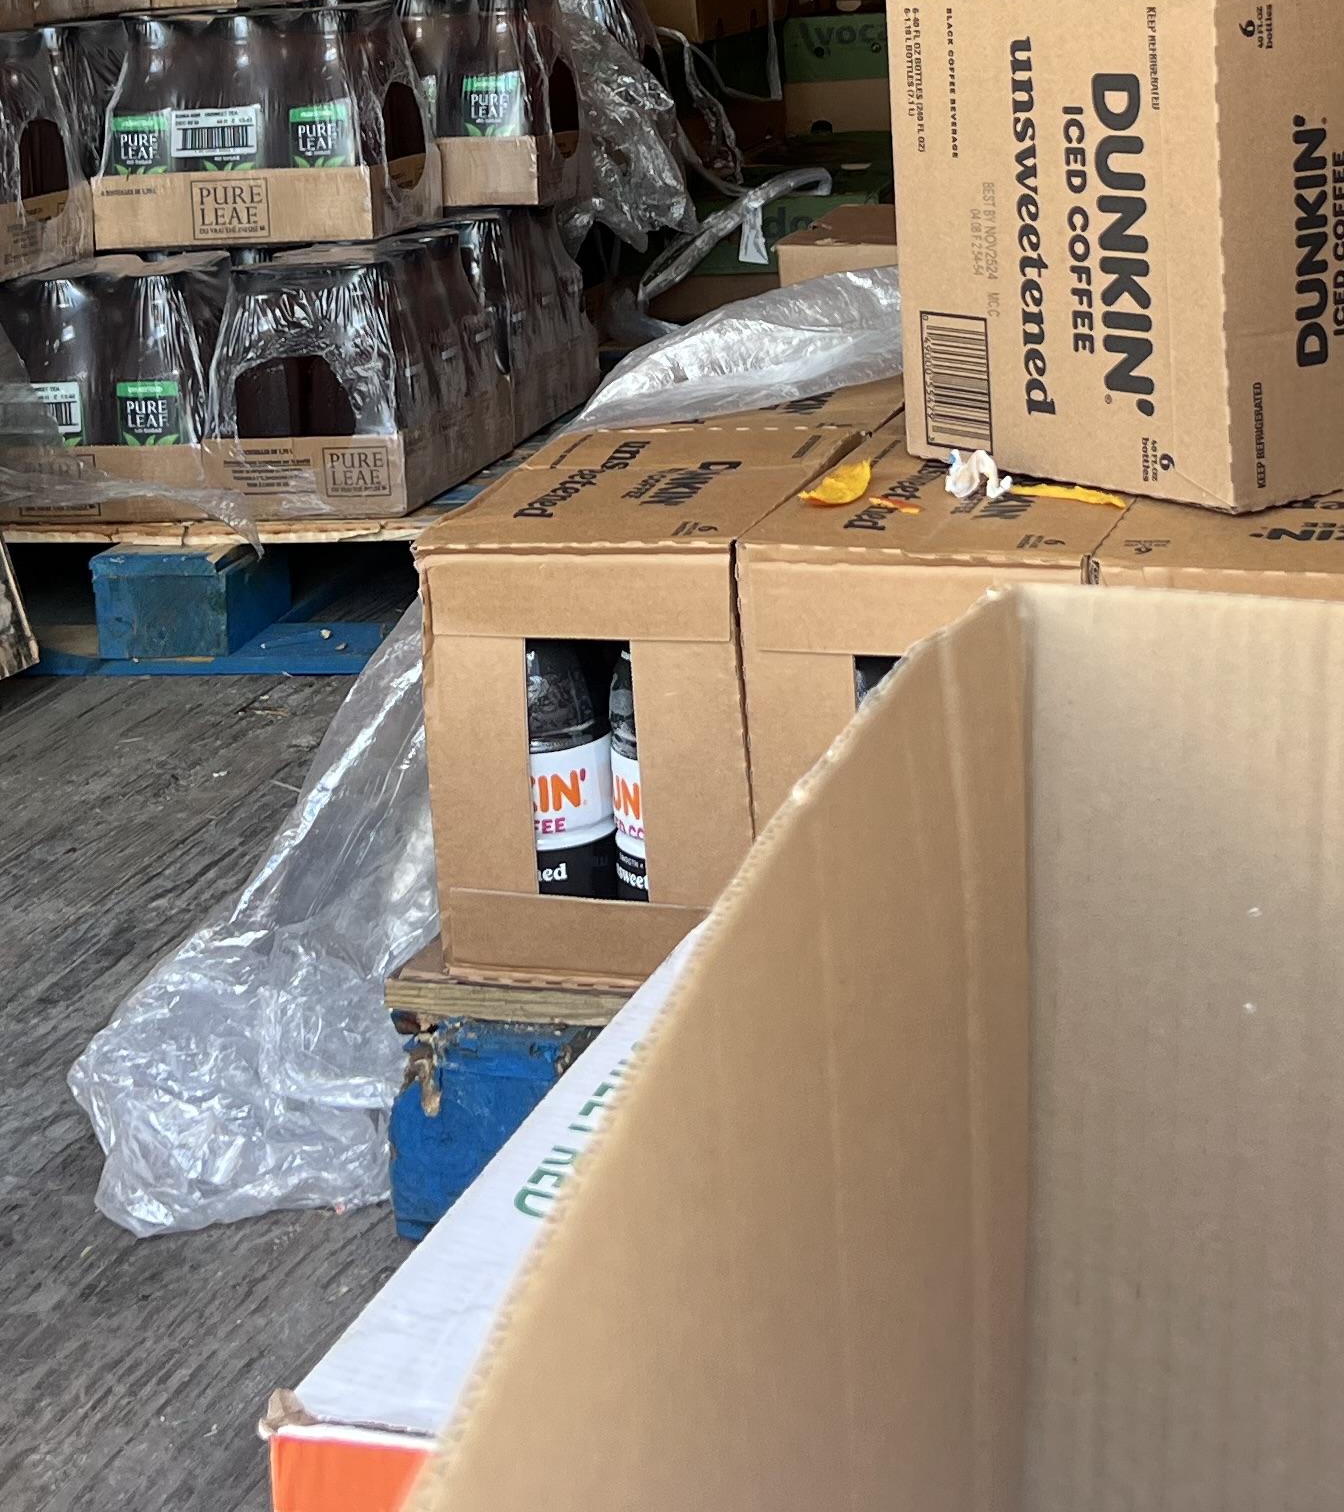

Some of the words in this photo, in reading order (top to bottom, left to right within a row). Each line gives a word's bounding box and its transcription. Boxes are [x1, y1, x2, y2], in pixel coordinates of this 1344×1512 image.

[946, 8, 954, 45] BLACK
[1146, 6, 1156, 33] KEEP
[1239, 19, 1256, 38] 6
[905, 44, 914, 88] BOTTLES
[914, 57, 923, 100] BOTTLES
[948, 50, 956, 95] COFFEE
[1148, 35, 1160, 111] REFRIGERATED
[471, 92, 509, 106] PURE
[471, 105, 506, 119] LEAF
[120, 133, 157, 148] PURE
[298, 123, 337, 138] PURE
[950, 98, 959, 158] BEVERAGE
[121, 146, 157, 160] LEAF
[298, 137, 336, 152] LEAF
[1062, 106, 1087, 194] ICED
[198, 184, 263, 205] PURE
[983, 181, 996, 207] BEST
[200, 206, 259, 226] LEAF
[984, 208, 997, 222] BY
[1010, 36, 1056, 416] unsweetened
[986, 223, 998, 280] NOV2524
[1091, 73, 1155, 417] DUNKIN'
[1293, 114, 1329, 368] DUNKIN'
[1067, 206, 1095, 354] COFFEE
[126, 399, 168, 414] PURE
[128, 414, 168, 427] LEAF
[1253, 382, 1265, 459] REFRIGERATED
[329, 451, 384, 468] PURE
[1159, 453, 1176, 471] 6
[332, 469, 382, 486] LEAF
[1257, 460, 1266, 488] KEEP
